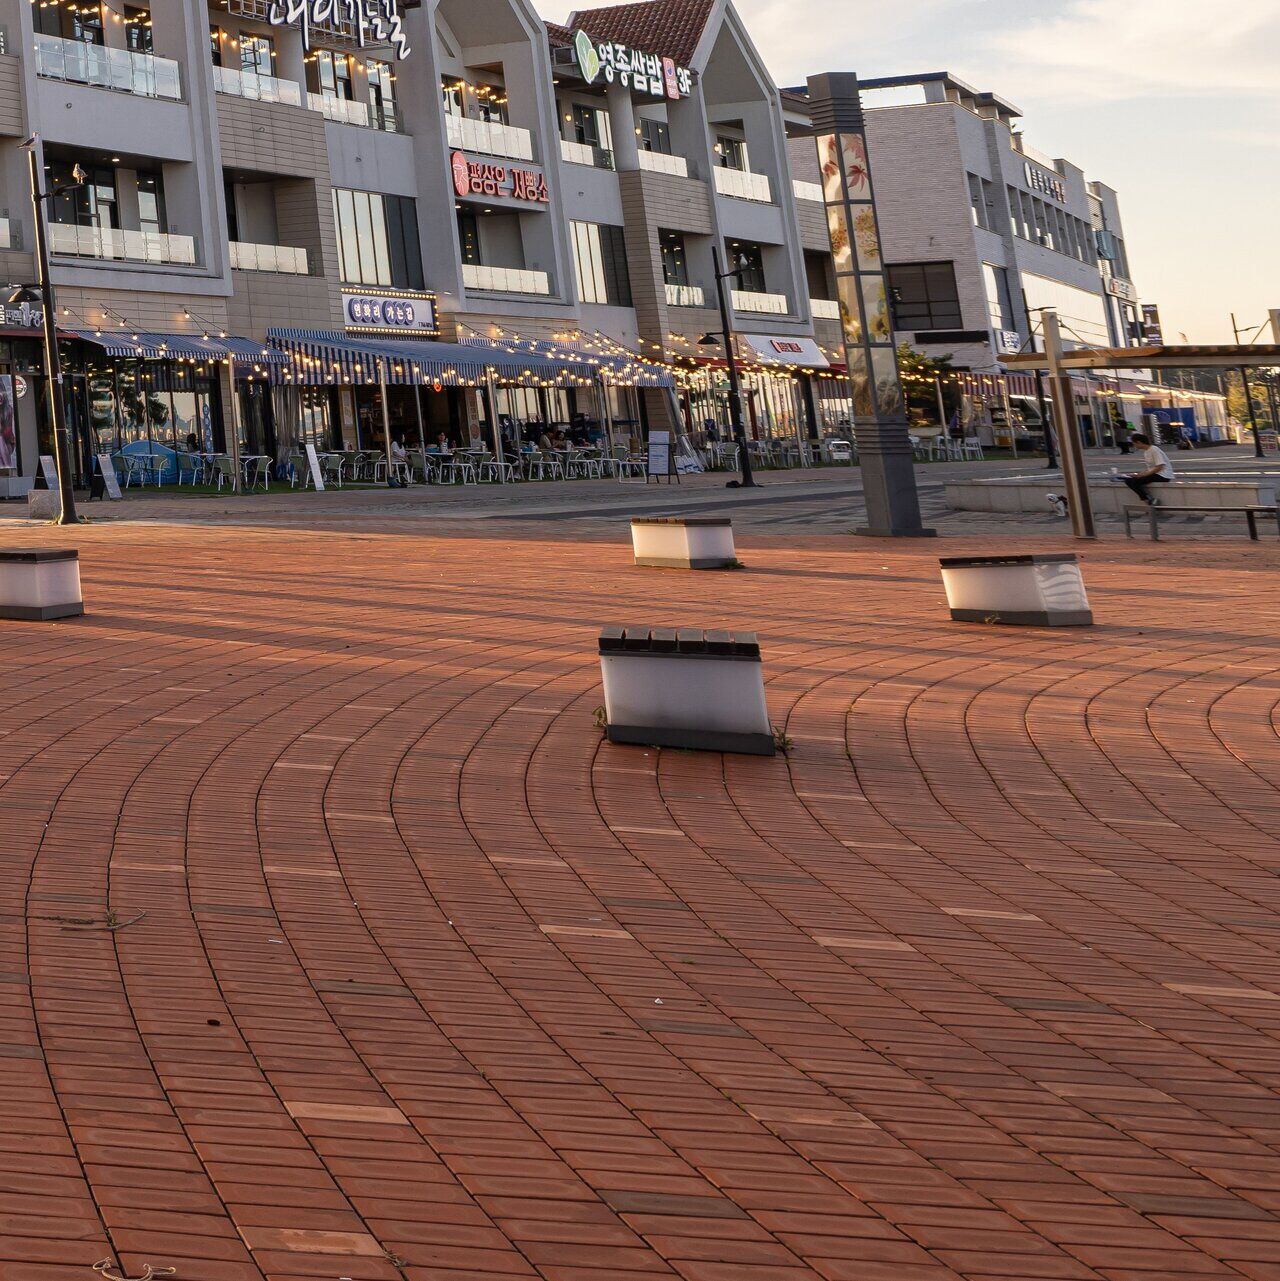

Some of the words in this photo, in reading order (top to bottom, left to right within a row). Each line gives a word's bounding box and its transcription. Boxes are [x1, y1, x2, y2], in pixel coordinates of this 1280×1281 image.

[598, 40, 665, 97] 영종쌈밥
[676, 66, 693, 95] 3F
[469, 161, 508, 197] 평상인
[511, 168, 550, 203] 제빵소
